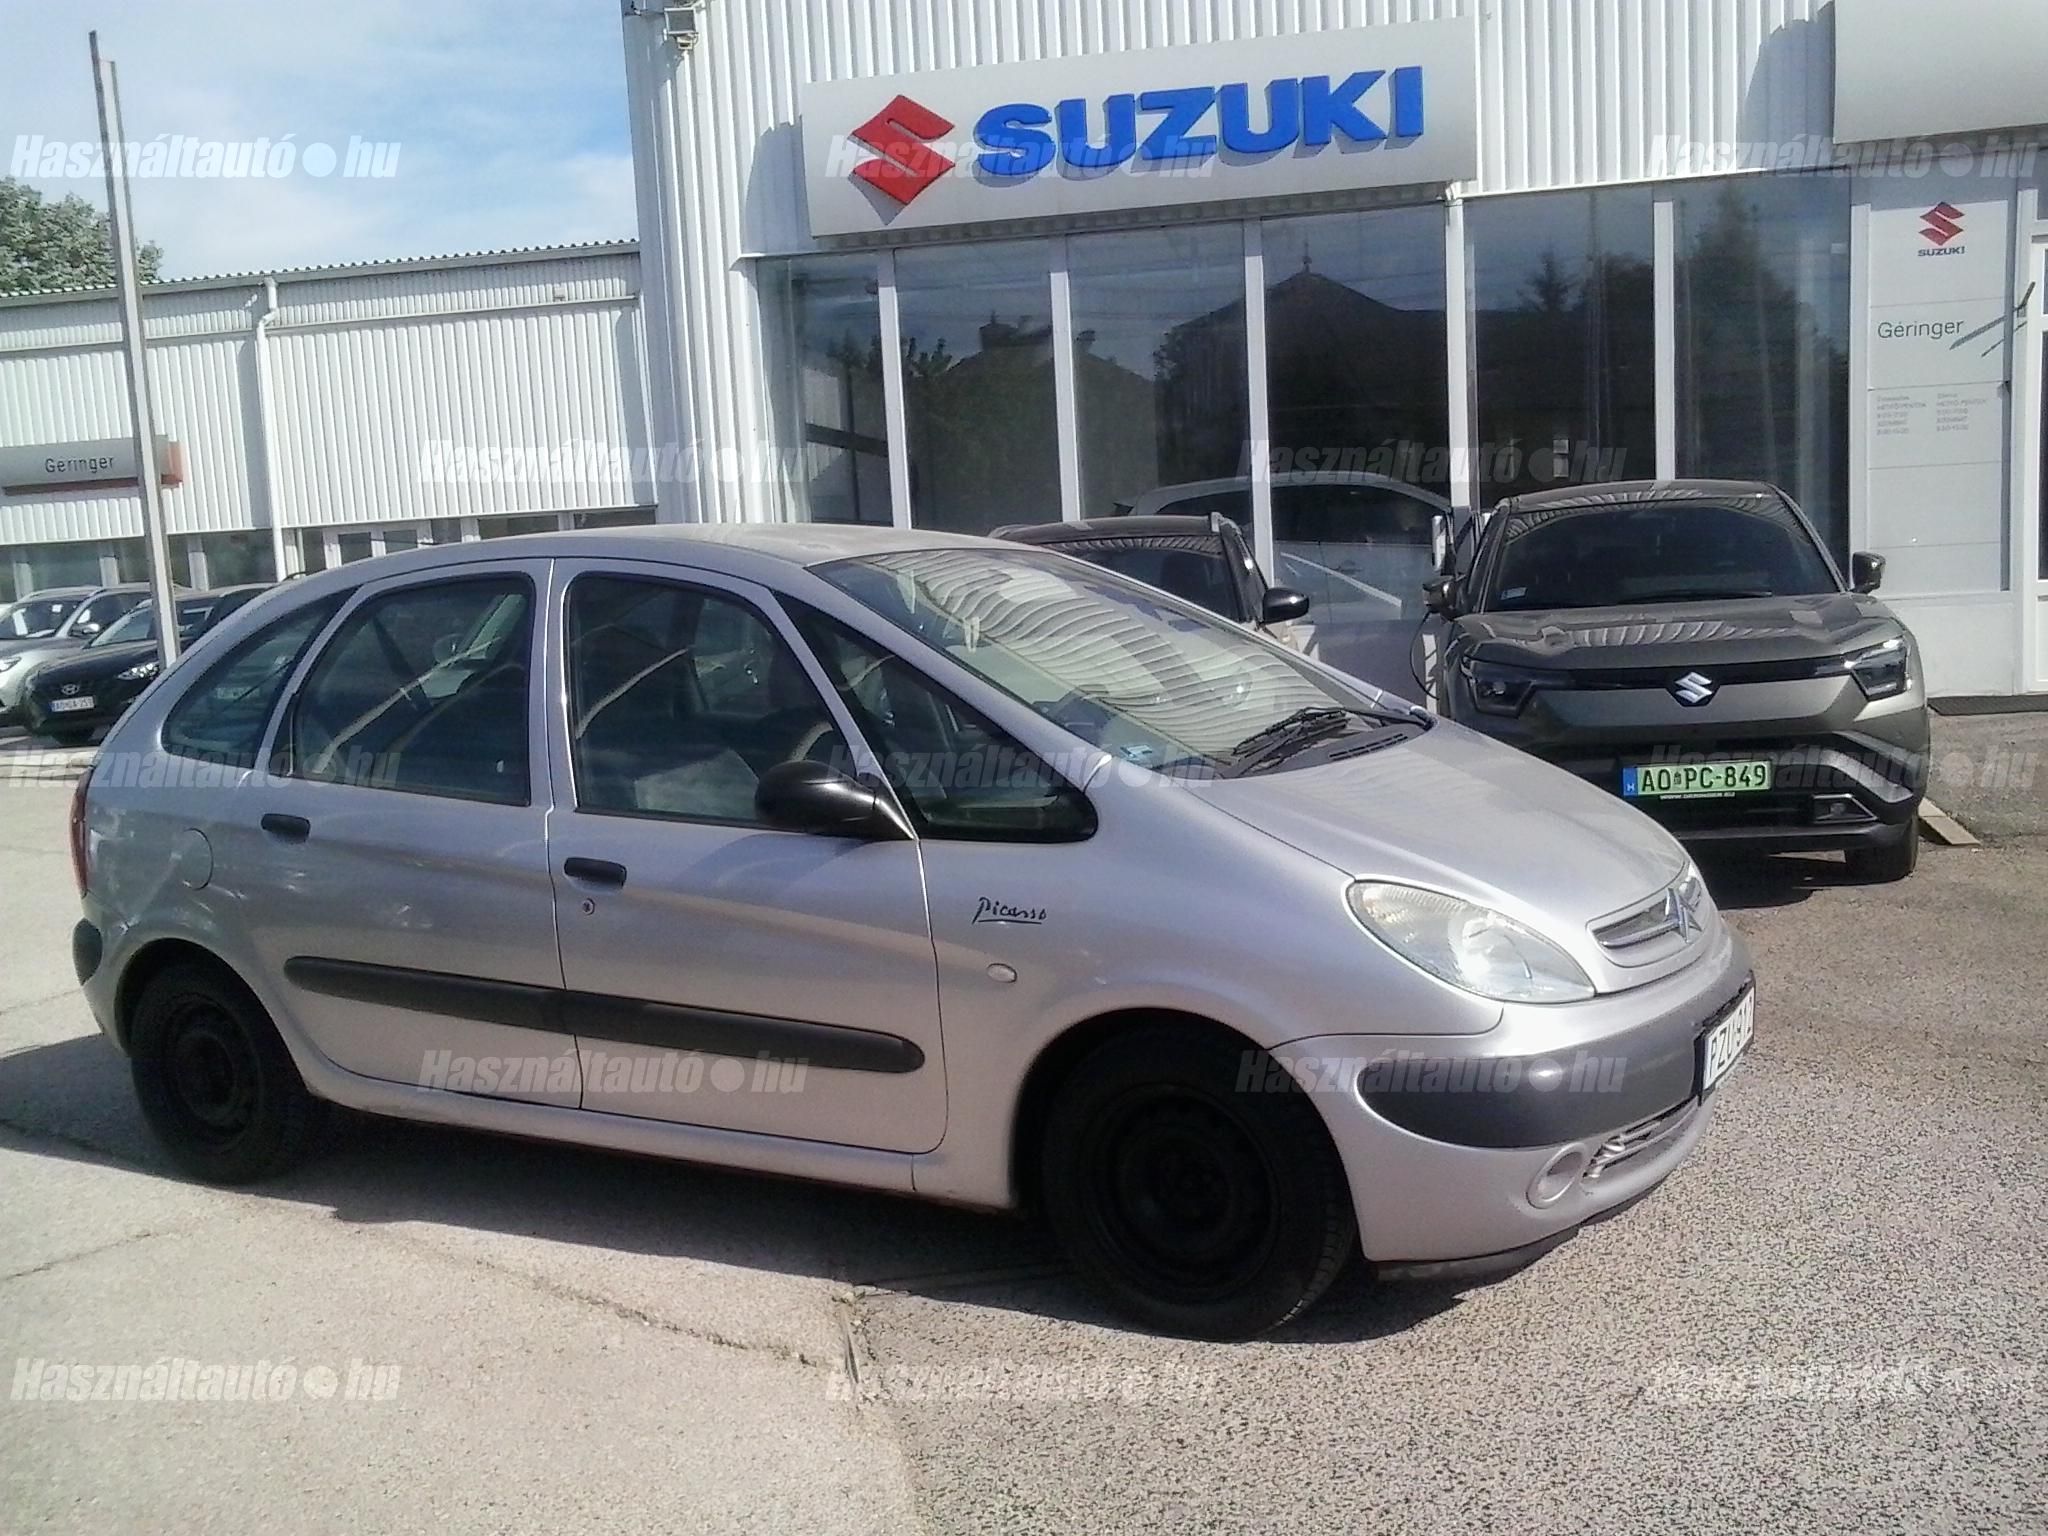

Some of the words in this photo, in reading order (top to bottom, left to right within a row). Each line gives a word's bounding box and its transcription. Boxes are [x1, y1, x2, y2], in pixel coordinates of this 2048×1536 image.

[976, 66, 1423, 176] SUZUKI
[1917, 245, 1966, 257] SUZUKI
[971, 896, 1047, 925] Picasso
